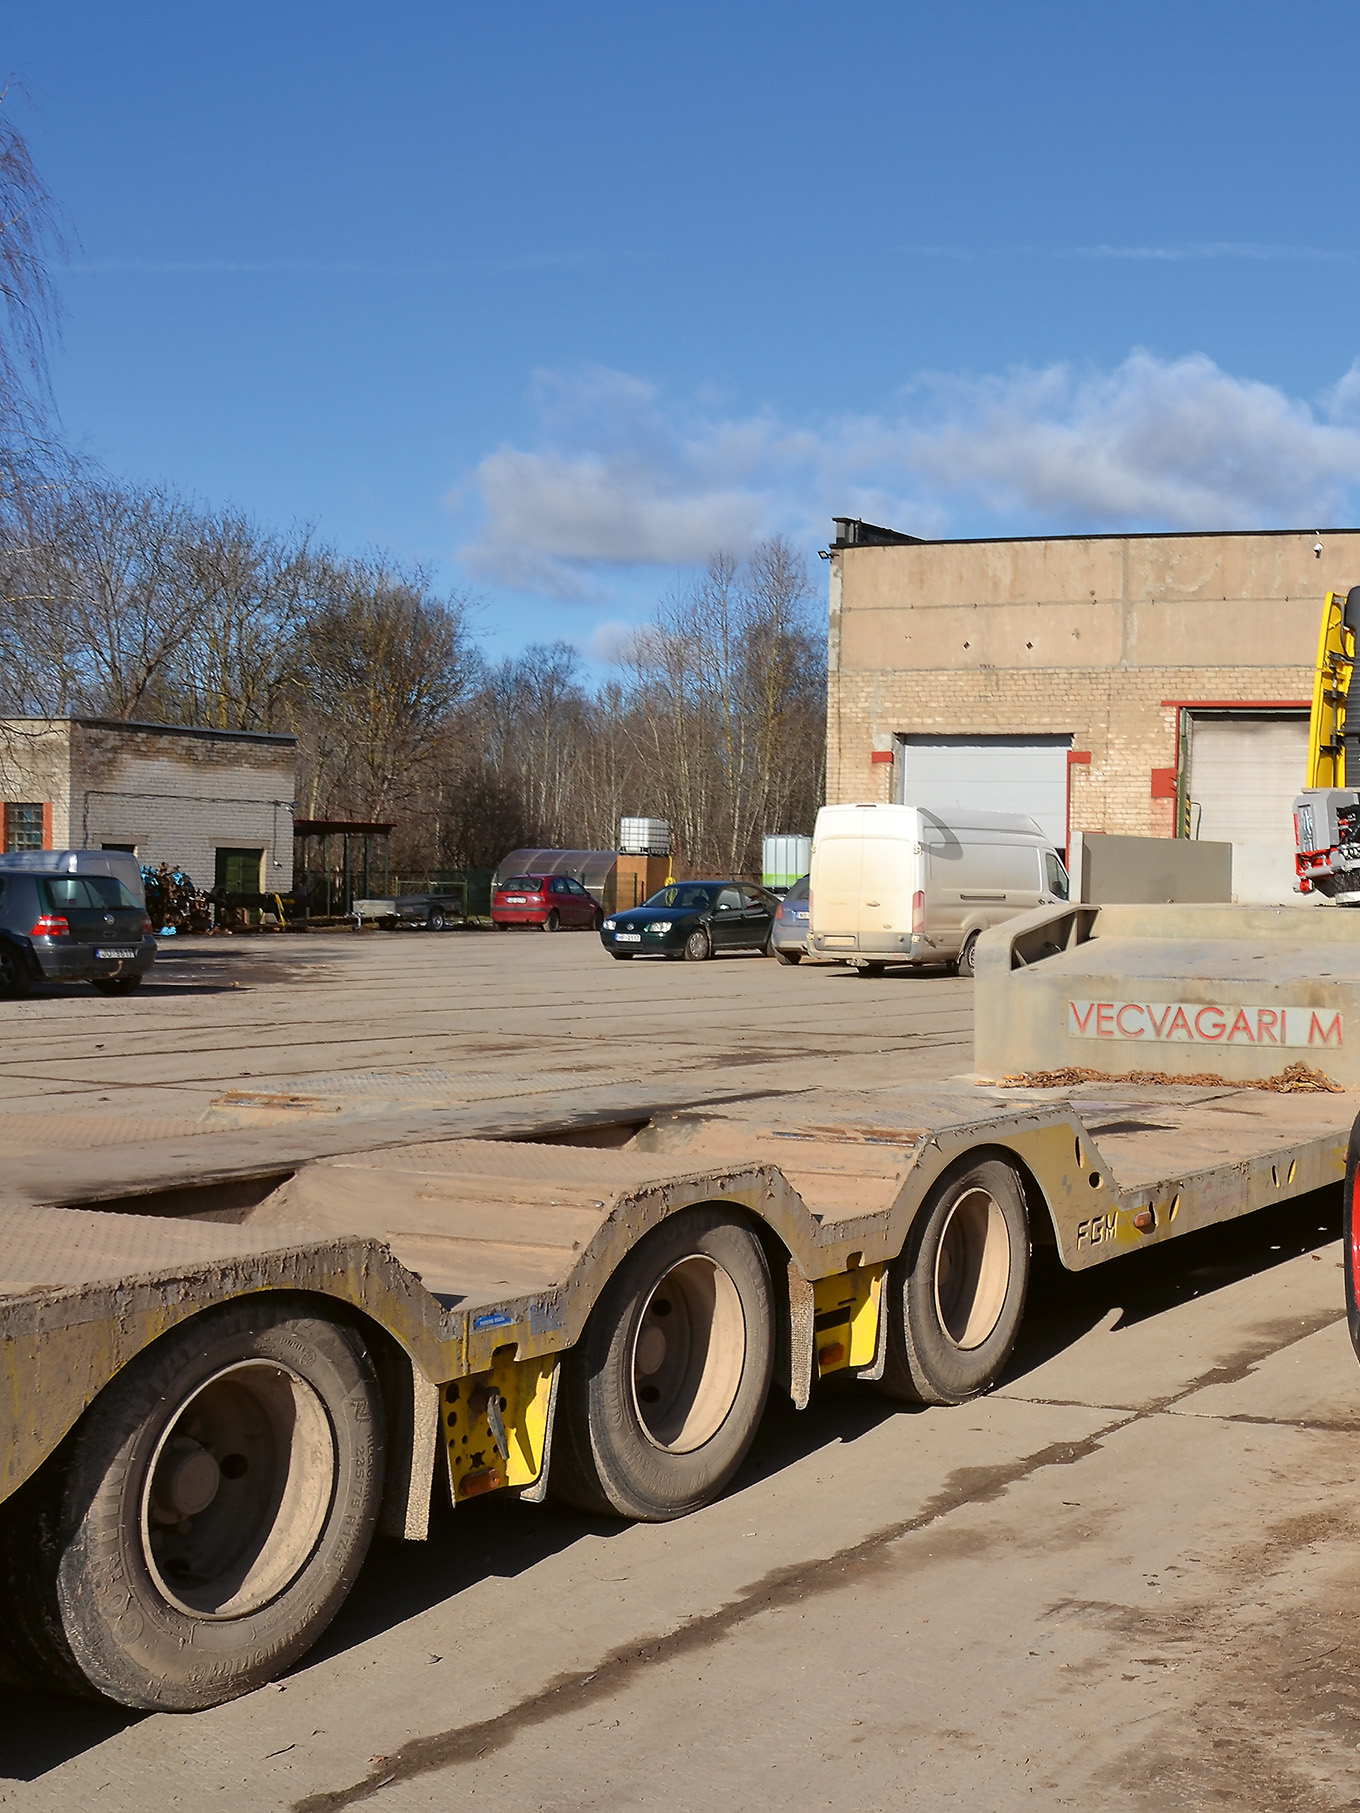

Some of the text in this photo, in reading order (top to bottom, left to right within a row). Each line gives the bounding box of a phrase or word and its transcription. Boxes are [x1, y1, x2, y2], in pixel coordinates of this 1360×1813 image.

[1071, 1002, 1343, 1046] VECVAGARI M
[1076, 1210, 1119, 1250] FGM
